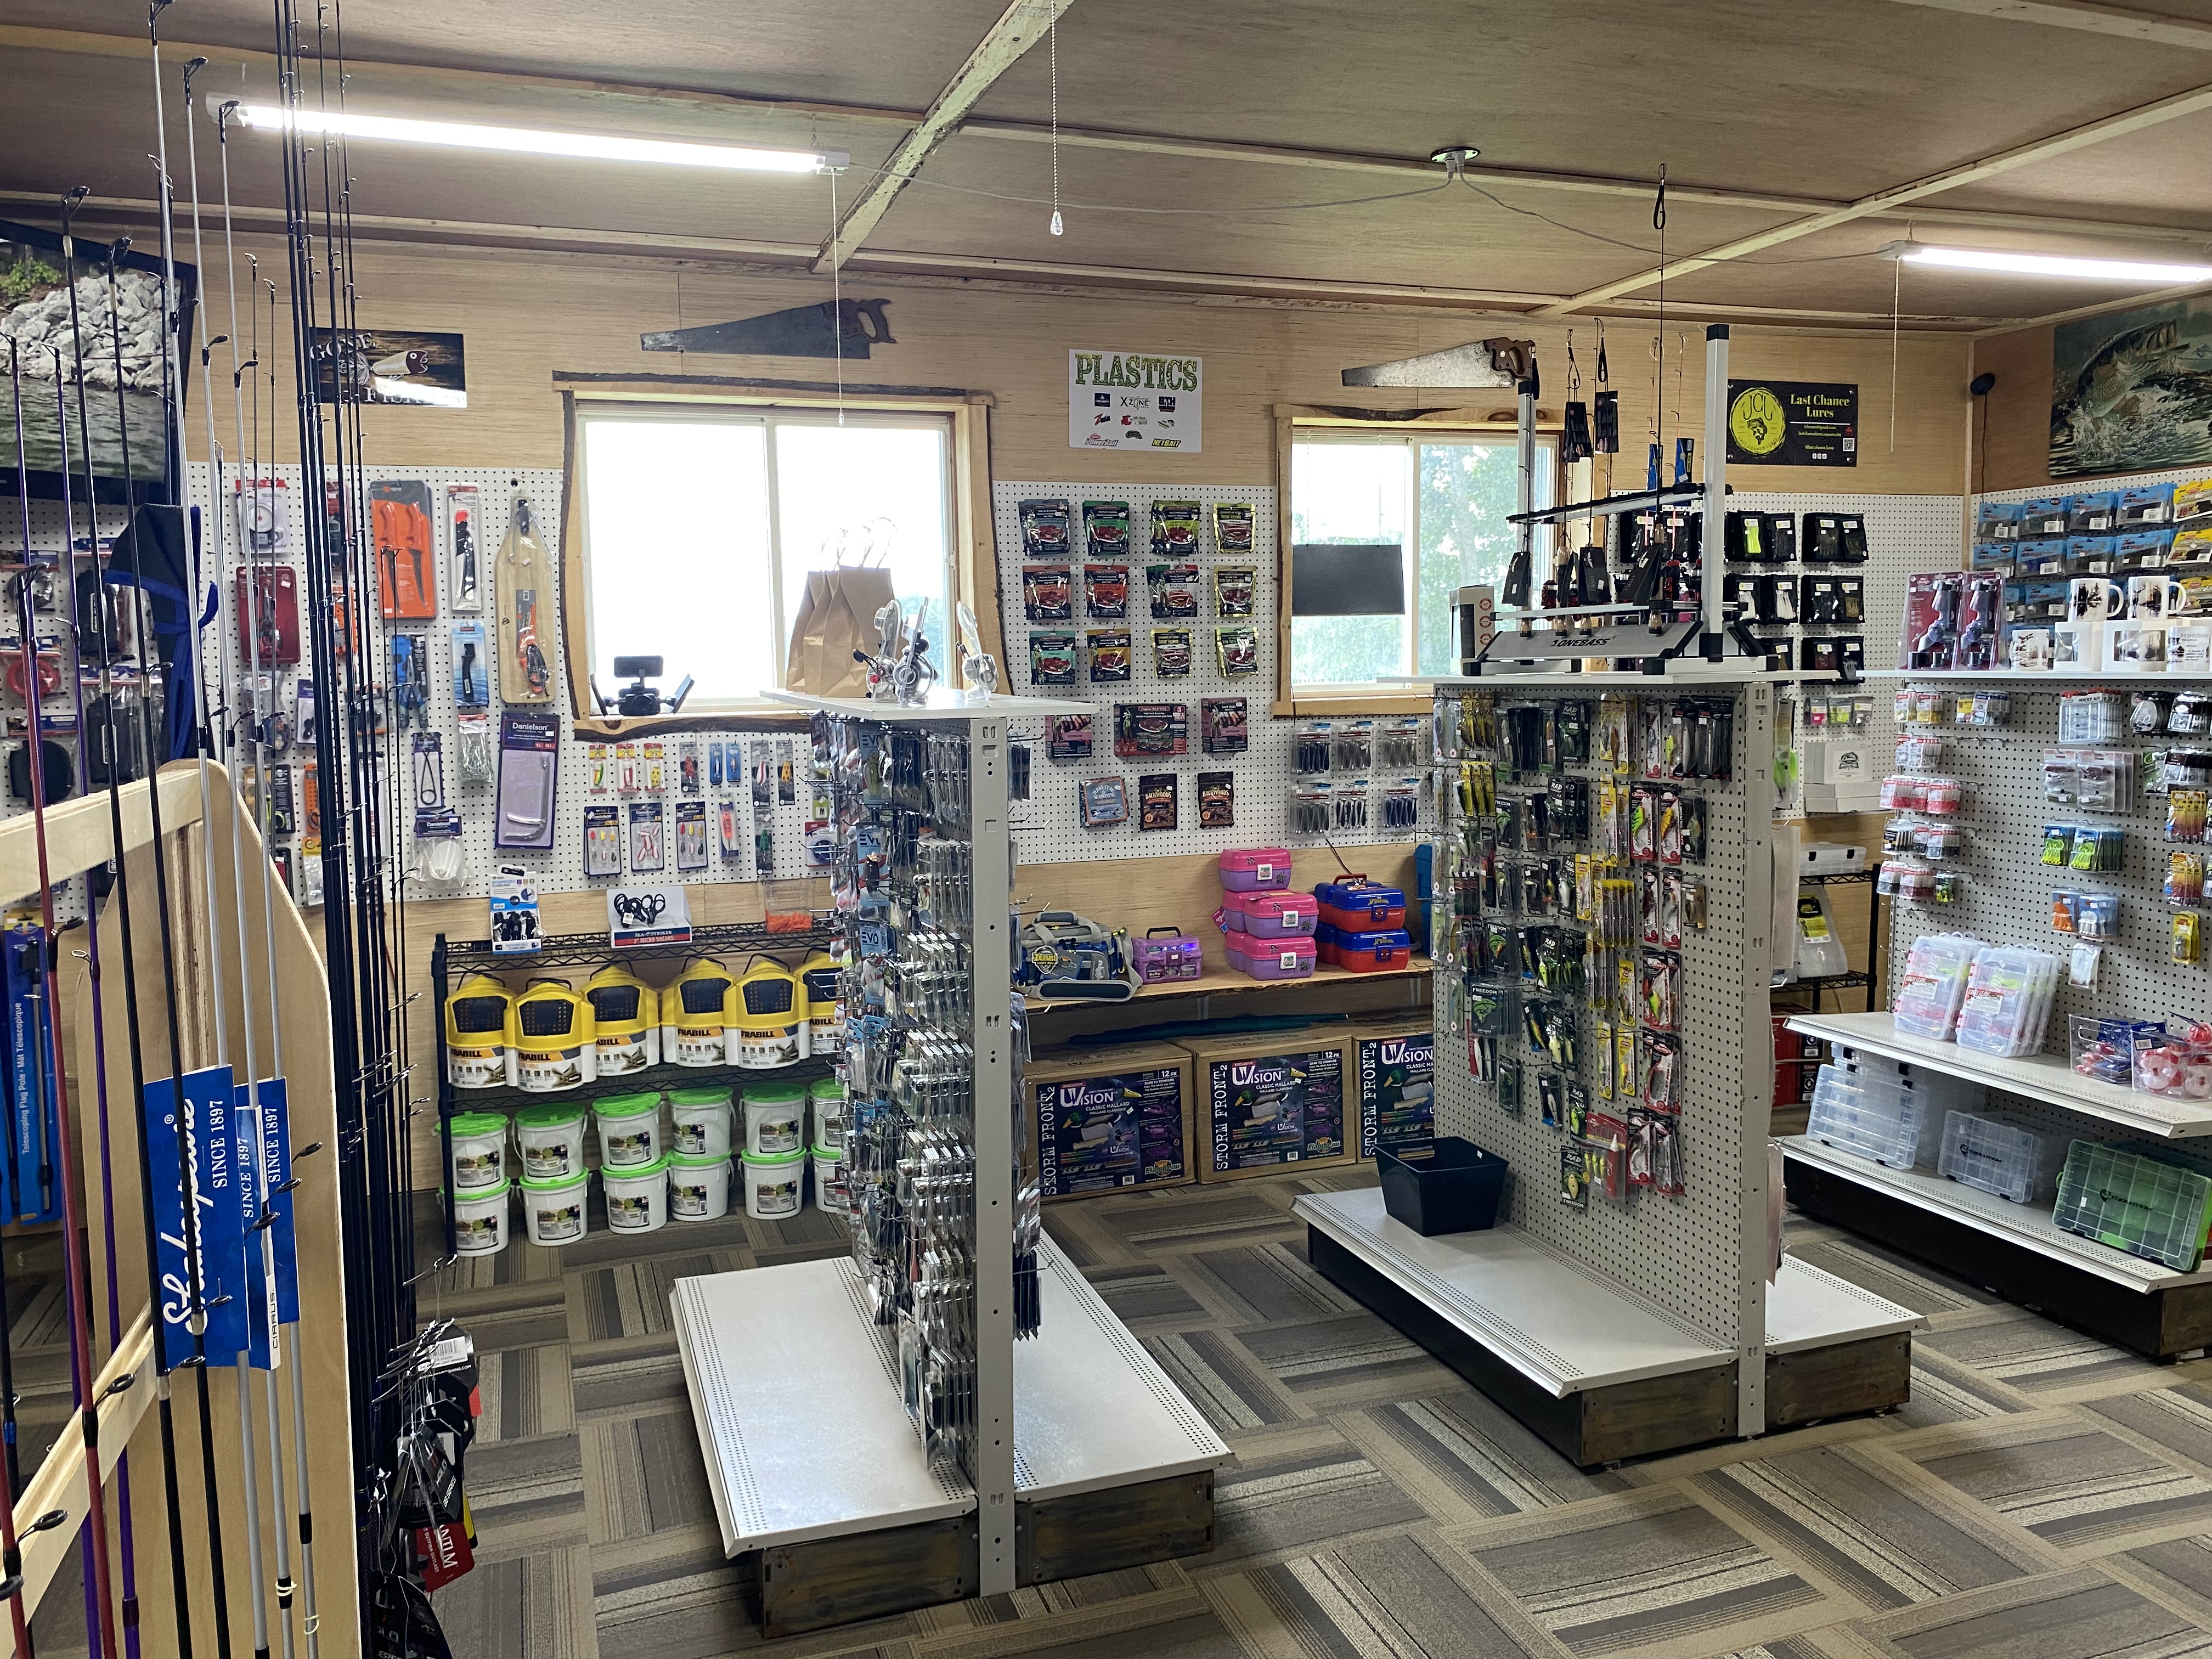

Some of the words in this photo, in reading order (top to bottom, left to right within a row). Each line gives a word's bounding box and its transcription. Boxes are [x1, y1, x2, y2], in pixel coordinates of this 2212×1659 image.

[1075, 353, 1198, 392] PLASTICS
[1790, 394, 1812, 405] Last
[1813, 394, 1850, 407] Chance
[1806, 407, 1834, 419] Lures
[1152, 438, 1181, 448] NETBAIT
[512, 722, 548, 731] Danielson
[1565, 859, 1575, 867] RAD
[862, 932, 878, 945] EVO
[1544, 937, 1555, 946] RAD
[1552, 1015, 1562, 1024] RAD
[1363, 1049, 1376, 1100] FRONT
[1214, 1070, 1228, 1118] FRONT
[1572, 1088, 1584, 1098] RAD
[209, 1100, 224, 1131] 1897
[264, 1108, 278, 1135] 1897
[1040, 1092, 1056, 1142] FRONT
[1364, 1104, 1378, 1156] STORM
[238, 1138, 250, 1167] 1897
[1216, 1122, 1228, 1170] STORM
[1567, 1154, 1581, 1163] RAD
[211, 1137, 227, 1188] SINCE
[268, 1138, 281, 1184] SINCE
[1043, 1146, 1057, 1195] STORM
[1144, 1163, 1182, 1175] Flambeau
[239, 1171, 254, 1218] SINCE
[1563, 1199, 1584, 1207] FREEDOM
